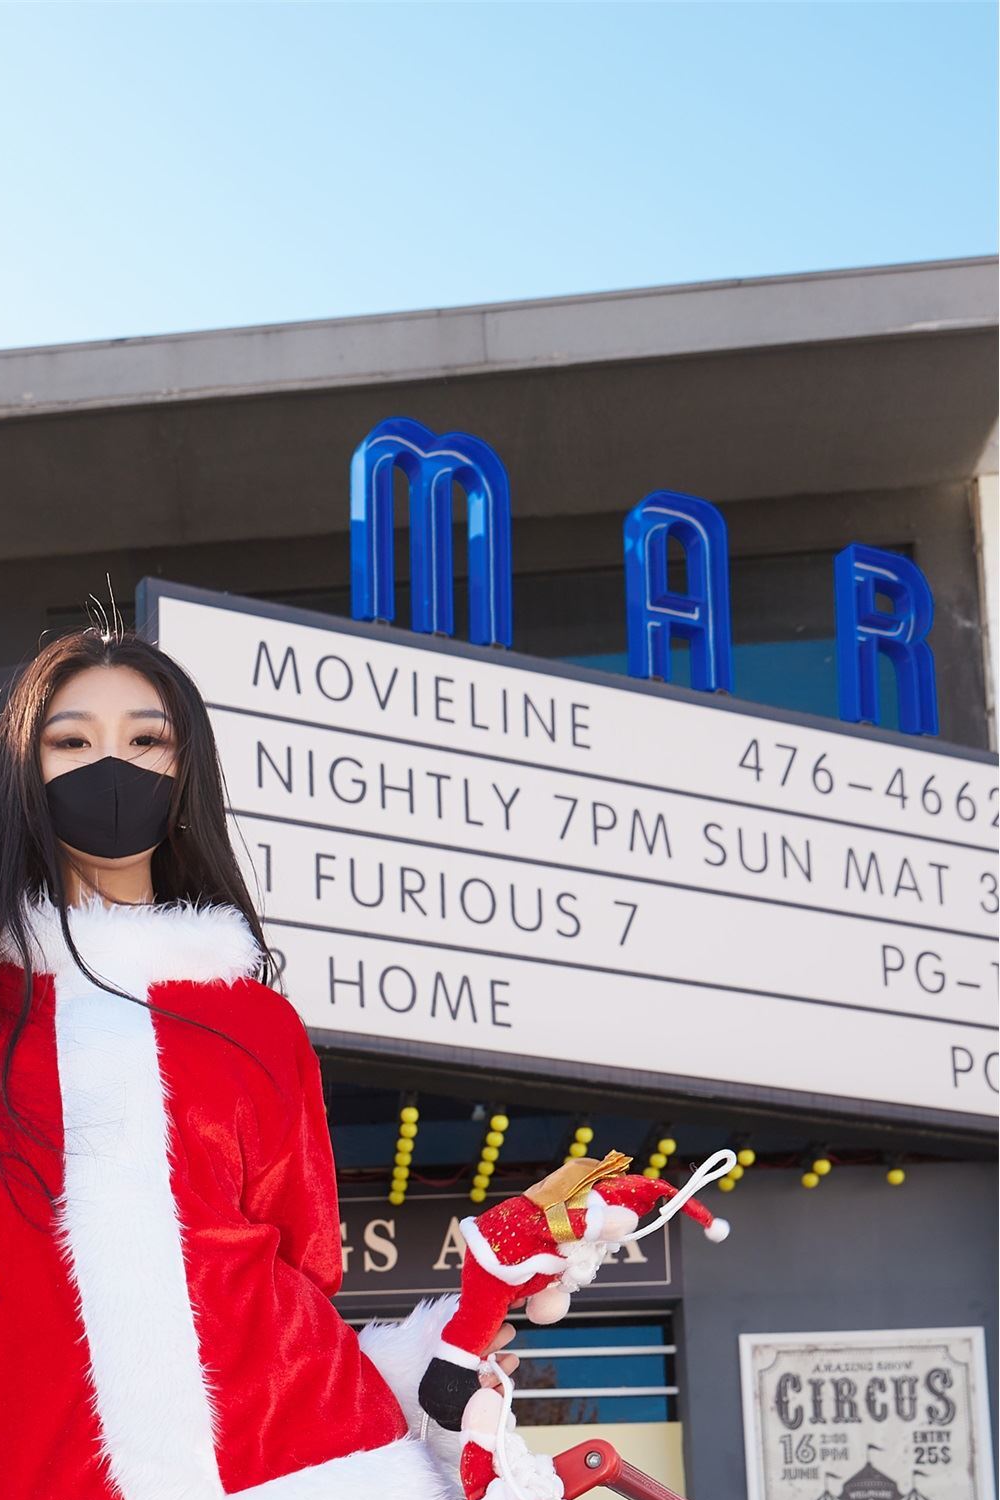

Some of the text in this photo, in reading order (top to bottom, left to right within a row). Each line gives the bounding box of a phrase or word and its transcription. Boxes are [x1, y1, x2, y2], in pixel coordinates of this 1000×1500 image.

[252, 641, 592, 750] MOVIELINE
[256, 741, 998, 914] NIGHTLY 7PM SUN MAT 3
[257, 843, 272, 892] 1
[315, 852, 581, 939] FURIOUS
[614, 900, 640, 946] 7
[329, 956, 513, 1029] HOME
[776, 1367, 956, 1430] CIRCUS
[779, 1432, 817, 1465] 16
[912, 1430, 953, 1444] ENTRY
[820, 1447, 849, 1461] PM
